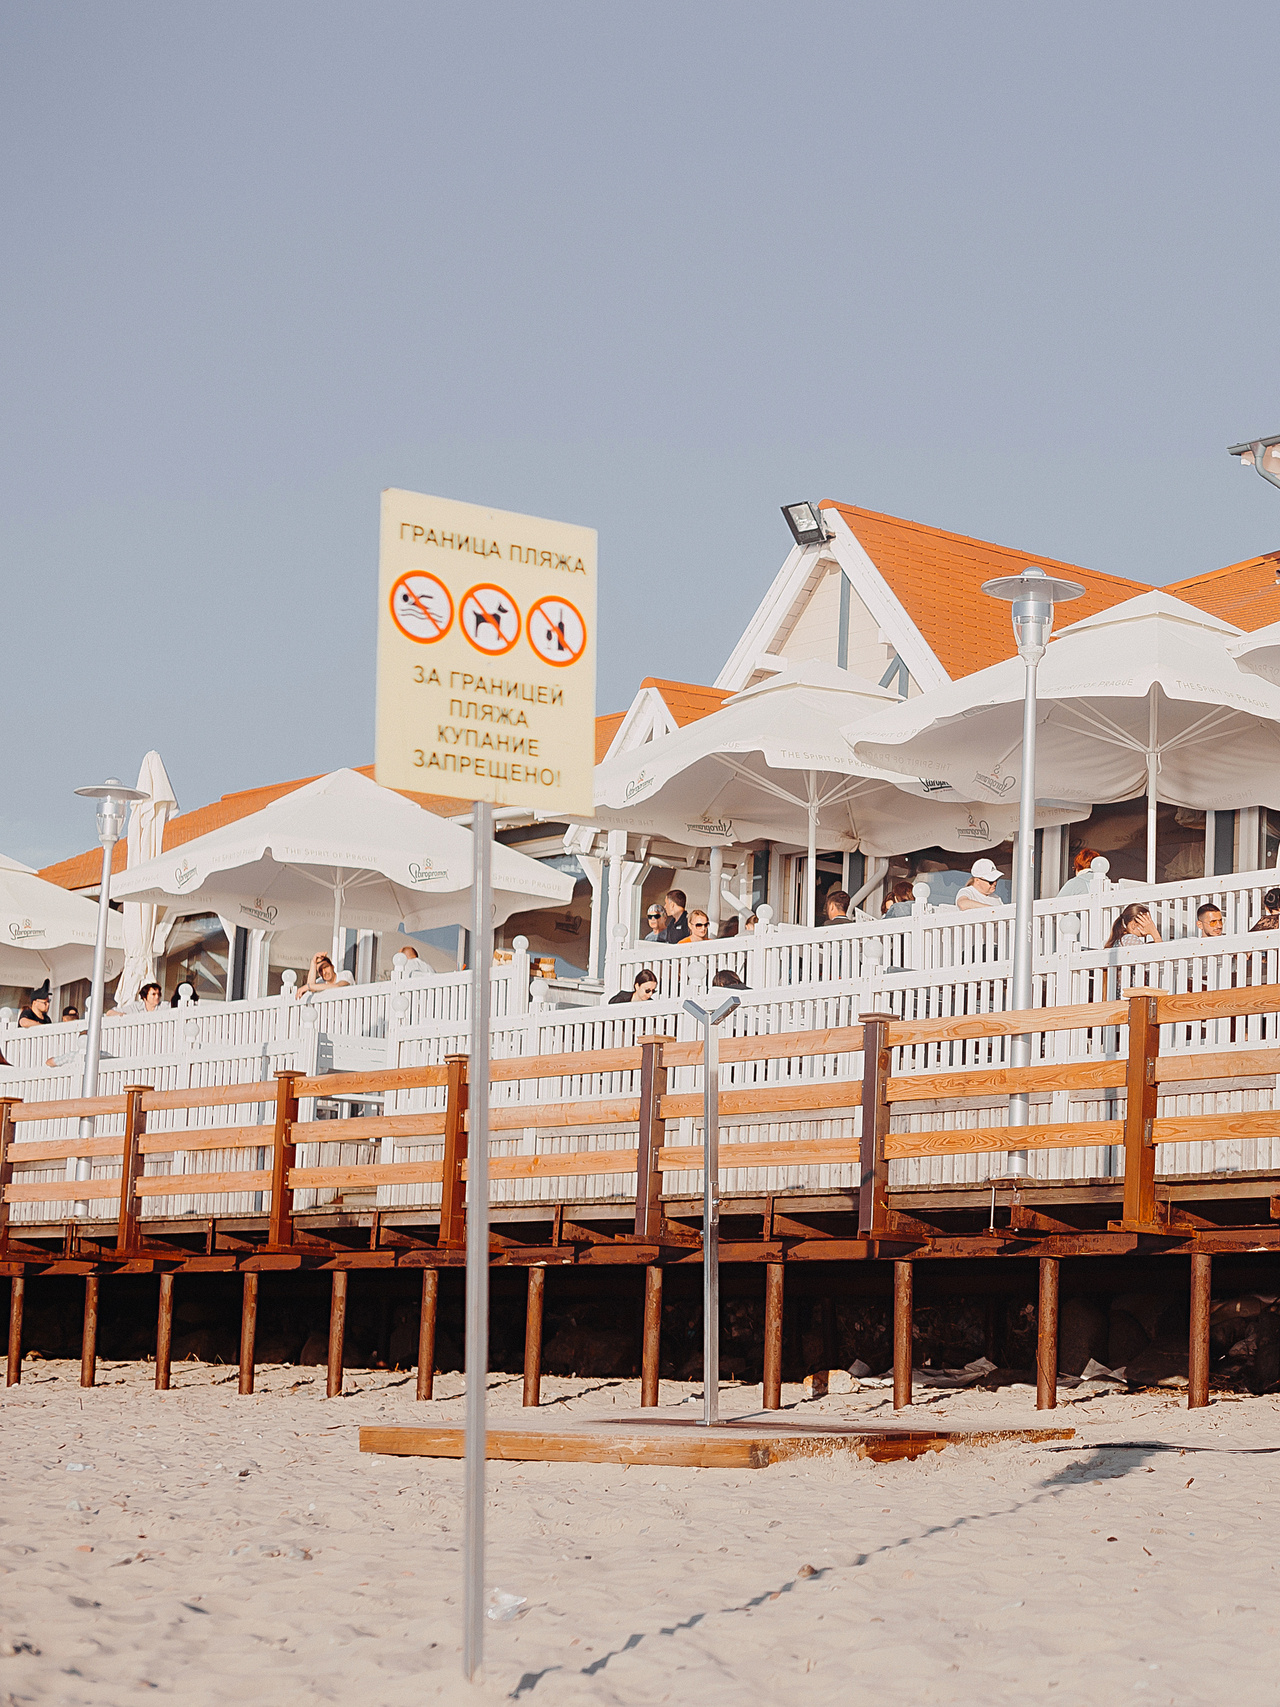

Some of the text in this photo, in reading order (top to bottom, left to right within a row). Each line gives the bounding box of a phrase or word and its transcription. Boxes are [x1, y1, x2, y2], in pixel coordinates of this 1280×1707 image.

[399, 522, 586, 575] ГРАНИЦА ПЛЯЖА
[413, 665, 563, 706] ЗА ГРАНИЦЕЙ
[1176, 680, 1196, 691] THE
[450, 699, 528, 728] ПЛЯЖА
[437, 725, 539, 757] КУПАНИЕ
[781, 749, 801, 759] THE
[803, 752, 831, 762] SPIRIT
[413, 749, 560, 787] ЗАПРЕЩЕНО!
[284, 846, 300, 855] THE
[304, 848, 330, 858] SPIRIT
[346, 852, 378, 864] PRAGUE
